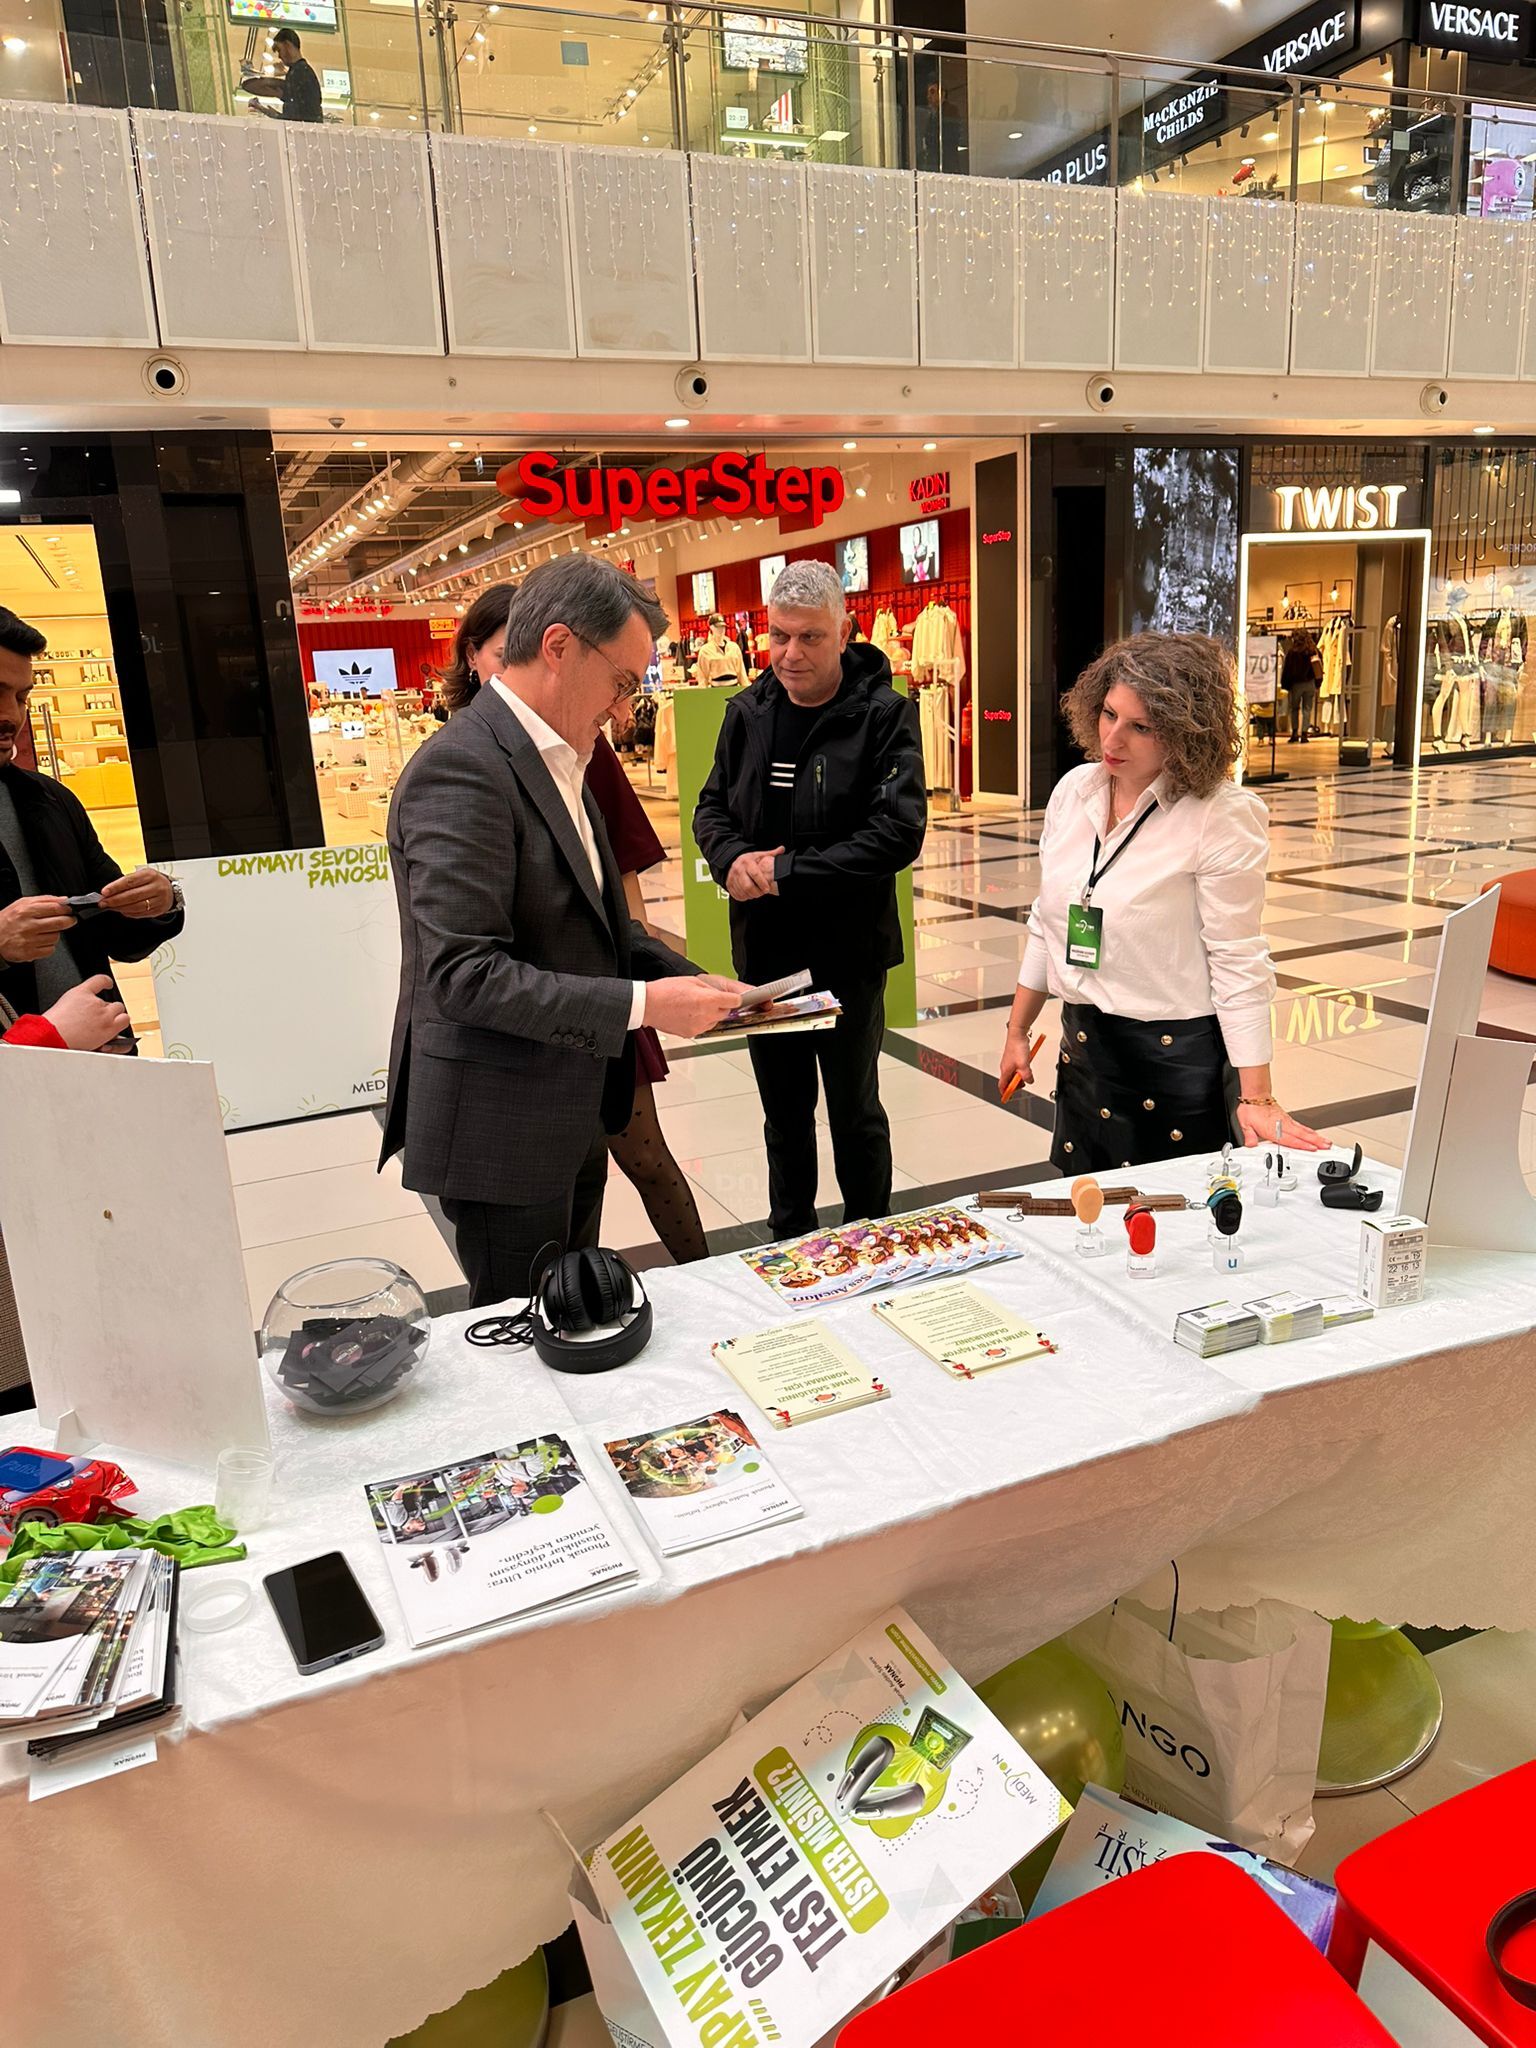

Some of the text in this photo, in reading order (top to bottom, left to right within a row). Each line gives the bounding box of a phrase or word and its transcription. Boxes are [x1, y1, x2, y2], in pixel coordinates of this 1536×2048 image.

[1262, 11, 1347, 73] VERSACE
[1429, 1, 1520, 42] VERSACE
[1066, 143, 1108, 184] PLUS
[518, 452, 844, 531] SuperStep
[909, 471, 949, 501] KADIN
[1274, 485, 1407, 530] TWIST
[982, 530, 1012, 545] SuperStep
[218, 853, 304, 877] DUYMAYI
[307, 864, 388, 888] PANOSU
[352, 1079, 388, 1094] MED
[804, 1370, 849, 1387] KORUMAK
[555, 1523, 601, 1544] yeniden
[488, 1540, 611, 1588] Phonak Infinio Ultra:
[590, 1562, 623, 1577] PHONAK
[884, 1663, 906, 1689] PHONAK
[1107, 1690, 1210, 1777] NGO
[767, 1763, 880, 1919] İSTER MİSİNİZ?
[712, 1776, 847, 1972] TEST ETMEK
[605, 1824, 706, 1977] ZEKANIN
[673, 1837, 784, 1988] GÜCÜNÜ
